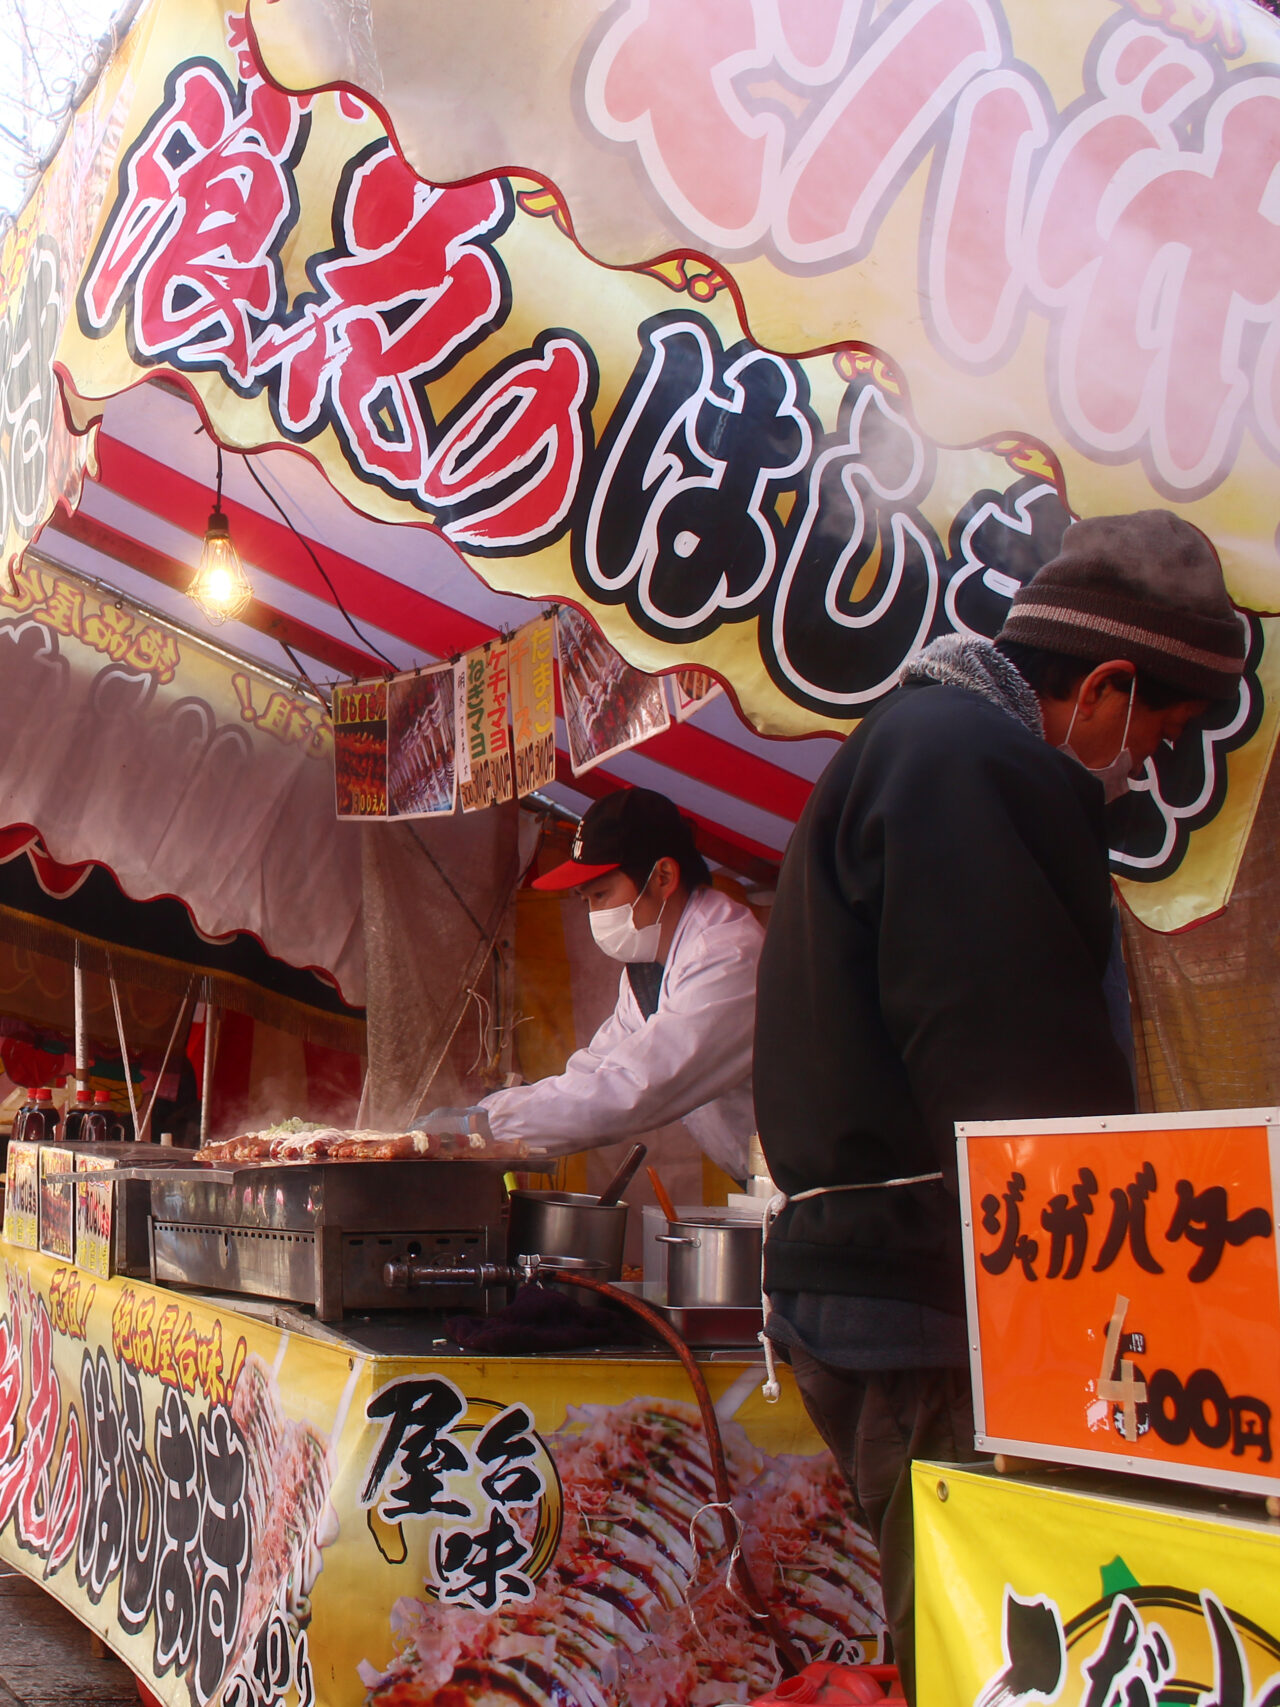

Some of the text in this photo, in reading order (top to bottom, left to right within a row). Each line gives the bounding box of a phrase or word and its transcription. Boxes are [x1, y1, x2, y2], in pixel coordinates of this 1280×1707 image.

[467, 658, 487, 759] ねぎマヨ
[487, 649, 507, 753] ケチャマヨ
[510, 637, 532, 744] チーズ
[531, 628, 553, 734] たまご
[980, 1160, 1272, 1283] ジャガバター
[357, 1374, 547, 1616] 屋台味
